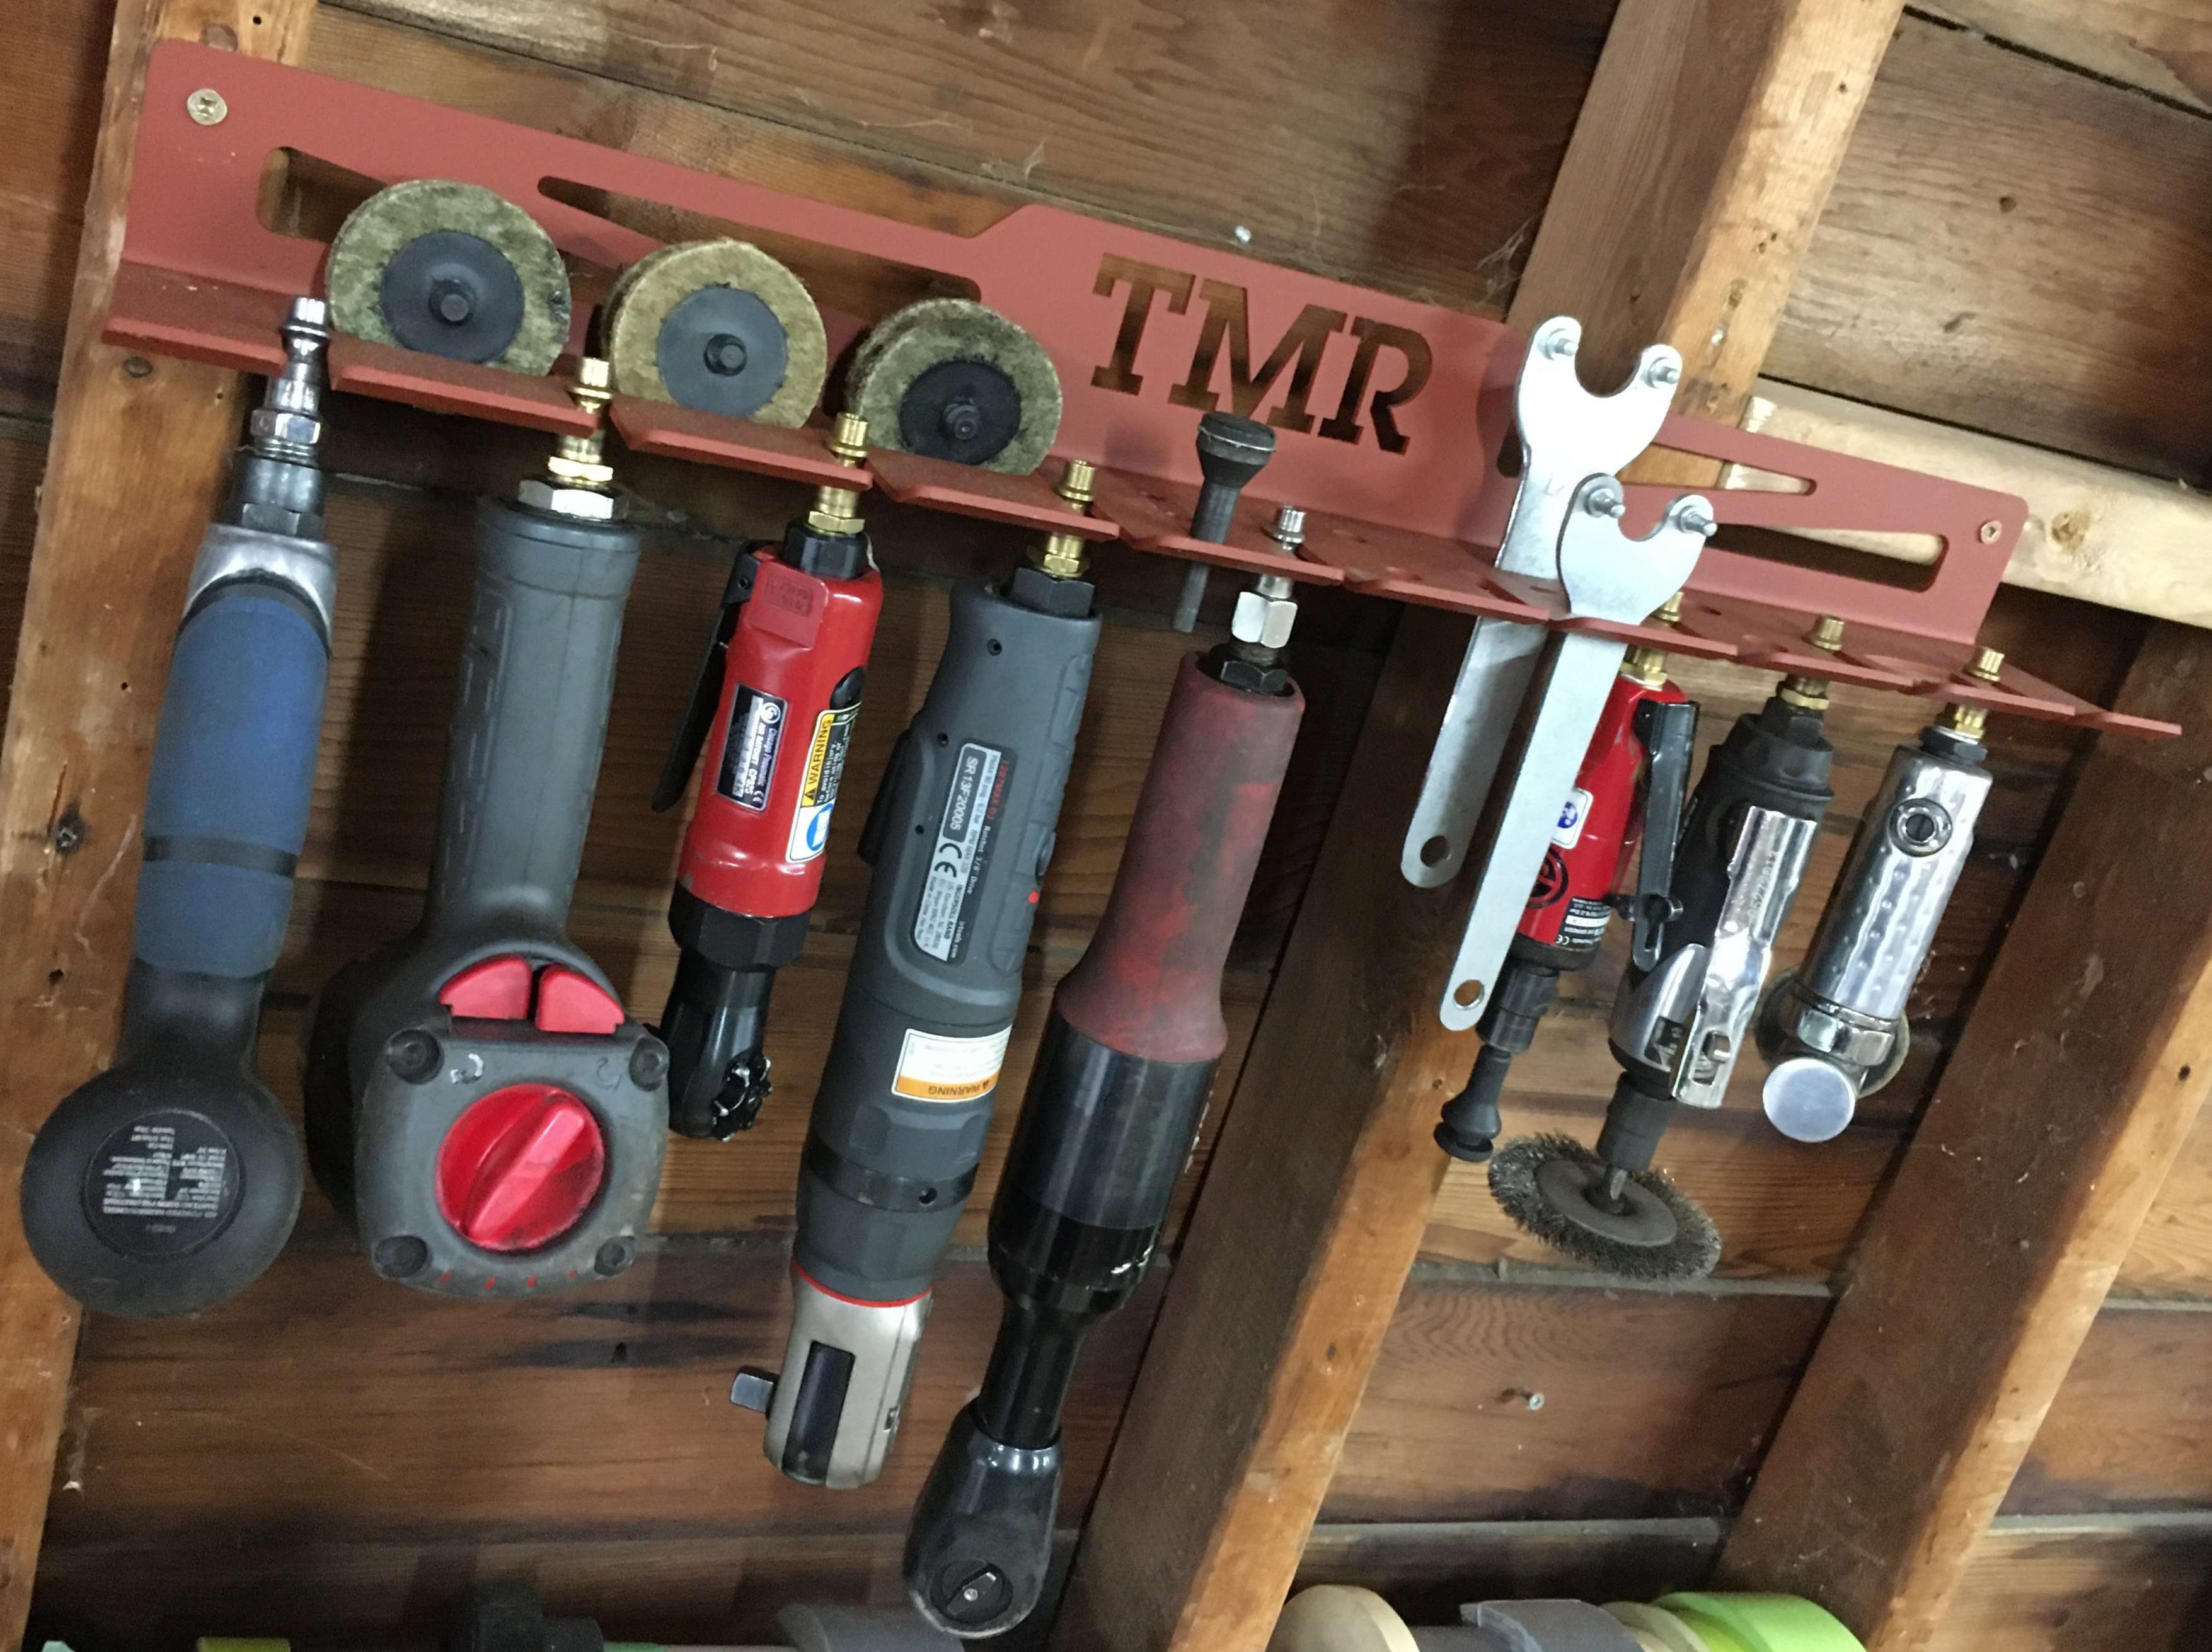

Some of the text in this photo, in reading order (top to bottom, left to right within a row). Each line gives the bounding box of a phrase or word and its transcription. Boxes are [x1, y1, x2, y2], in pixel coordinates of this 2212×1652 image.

[1091, 252, 1432, 456] TMR
[808, 720, 831, 784] WARNING
[928, 1084, 979, 1095] WARNING
